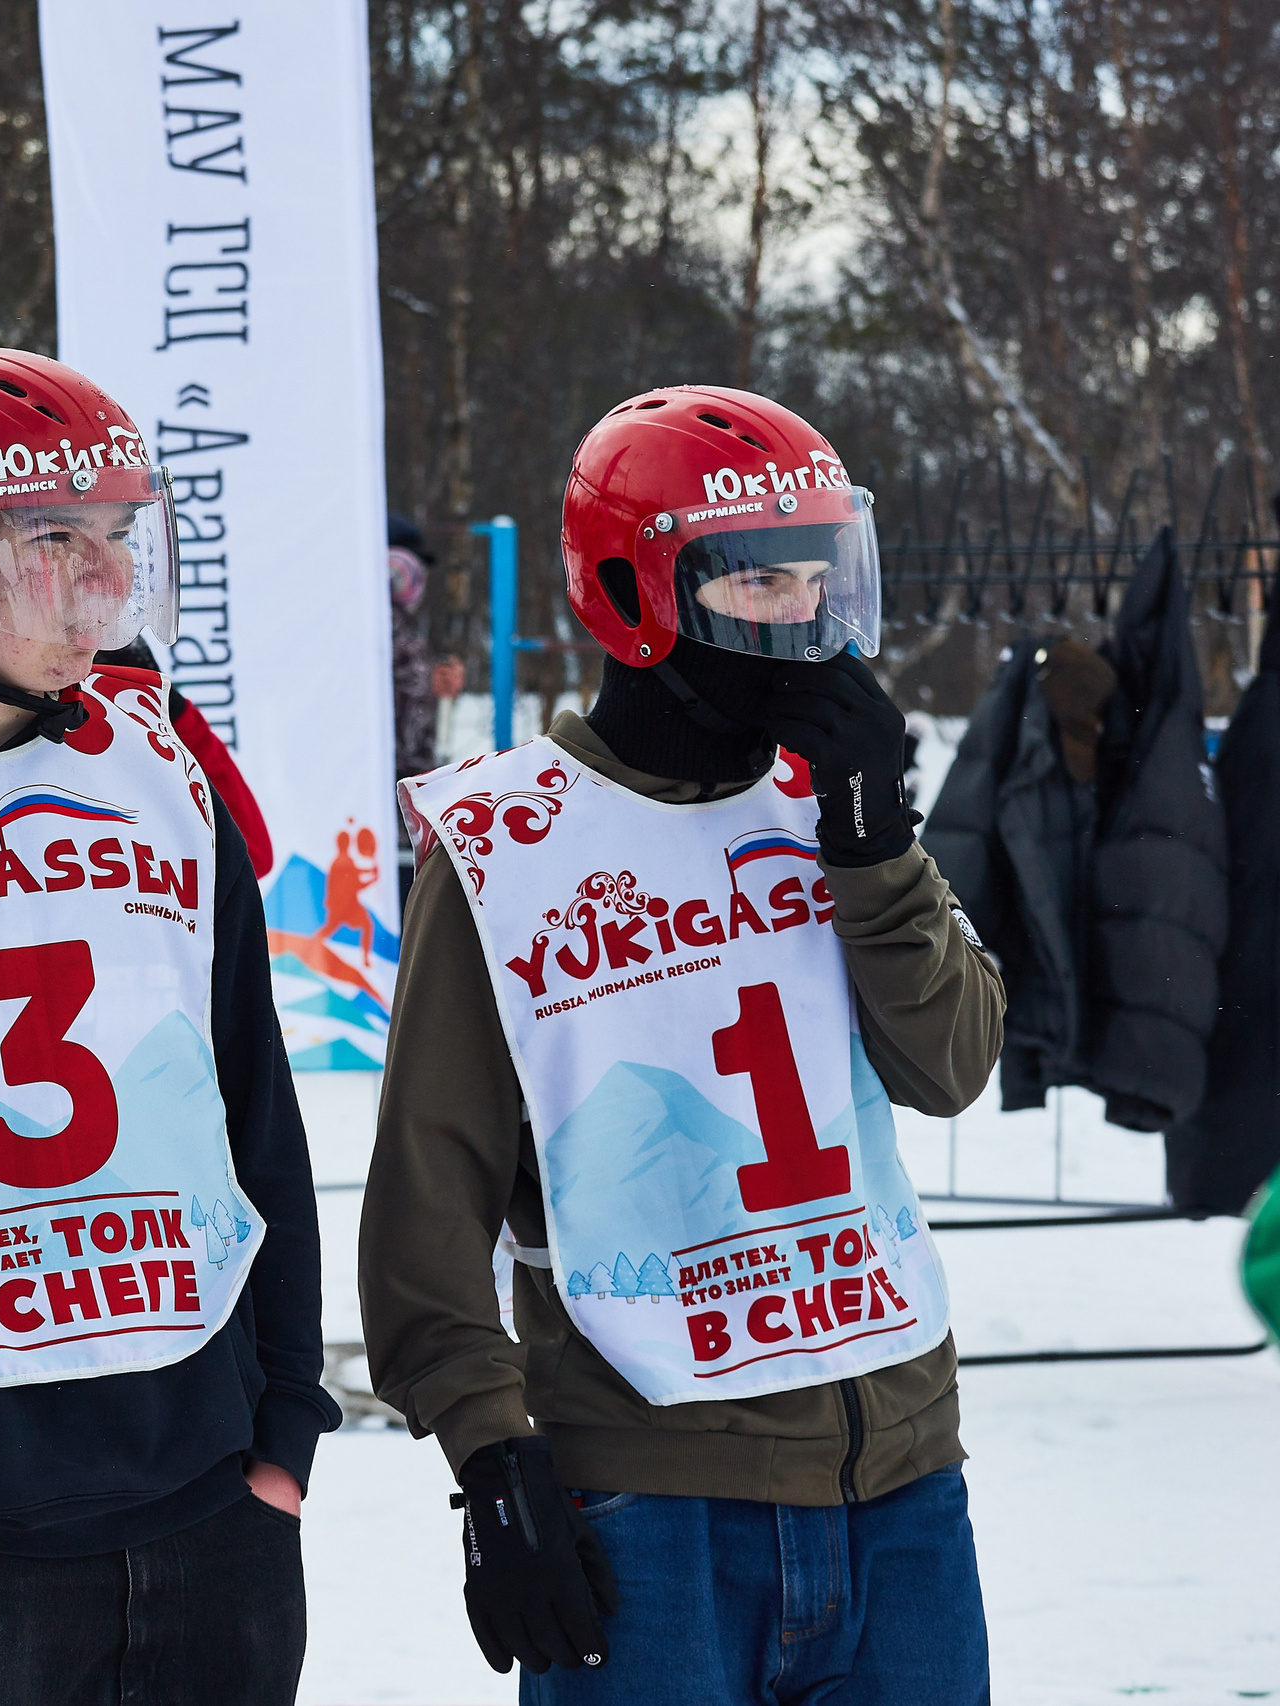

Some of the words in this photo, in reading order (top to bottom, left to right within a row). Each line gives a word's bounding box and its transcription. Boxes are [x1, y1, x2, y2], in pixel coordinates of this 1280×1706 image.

[156, 19, 247, 186] МАУ
[154, 216, 250, 352] ГСЦ
[687, 502, 764, 524] МУРМАНСК
[534, 995, 588, 1021] RUSSIA,
[588, 969, 665, 1002] MURMANSK
[666, 955, 722, 979] REGION
[711, 981, 852, 1213] 1
[50, 1208, 191, 1258] ТОЛК
[678, 1256, 728, 1289] ДЛЯ
[730, 1243, 787, 1272] ТЕХ,
[681, 1286, 723, 1307] КТО
[726, 1266, 792, 1296] ЗНАЕТ
[686, 1310, 732, 1362] В
